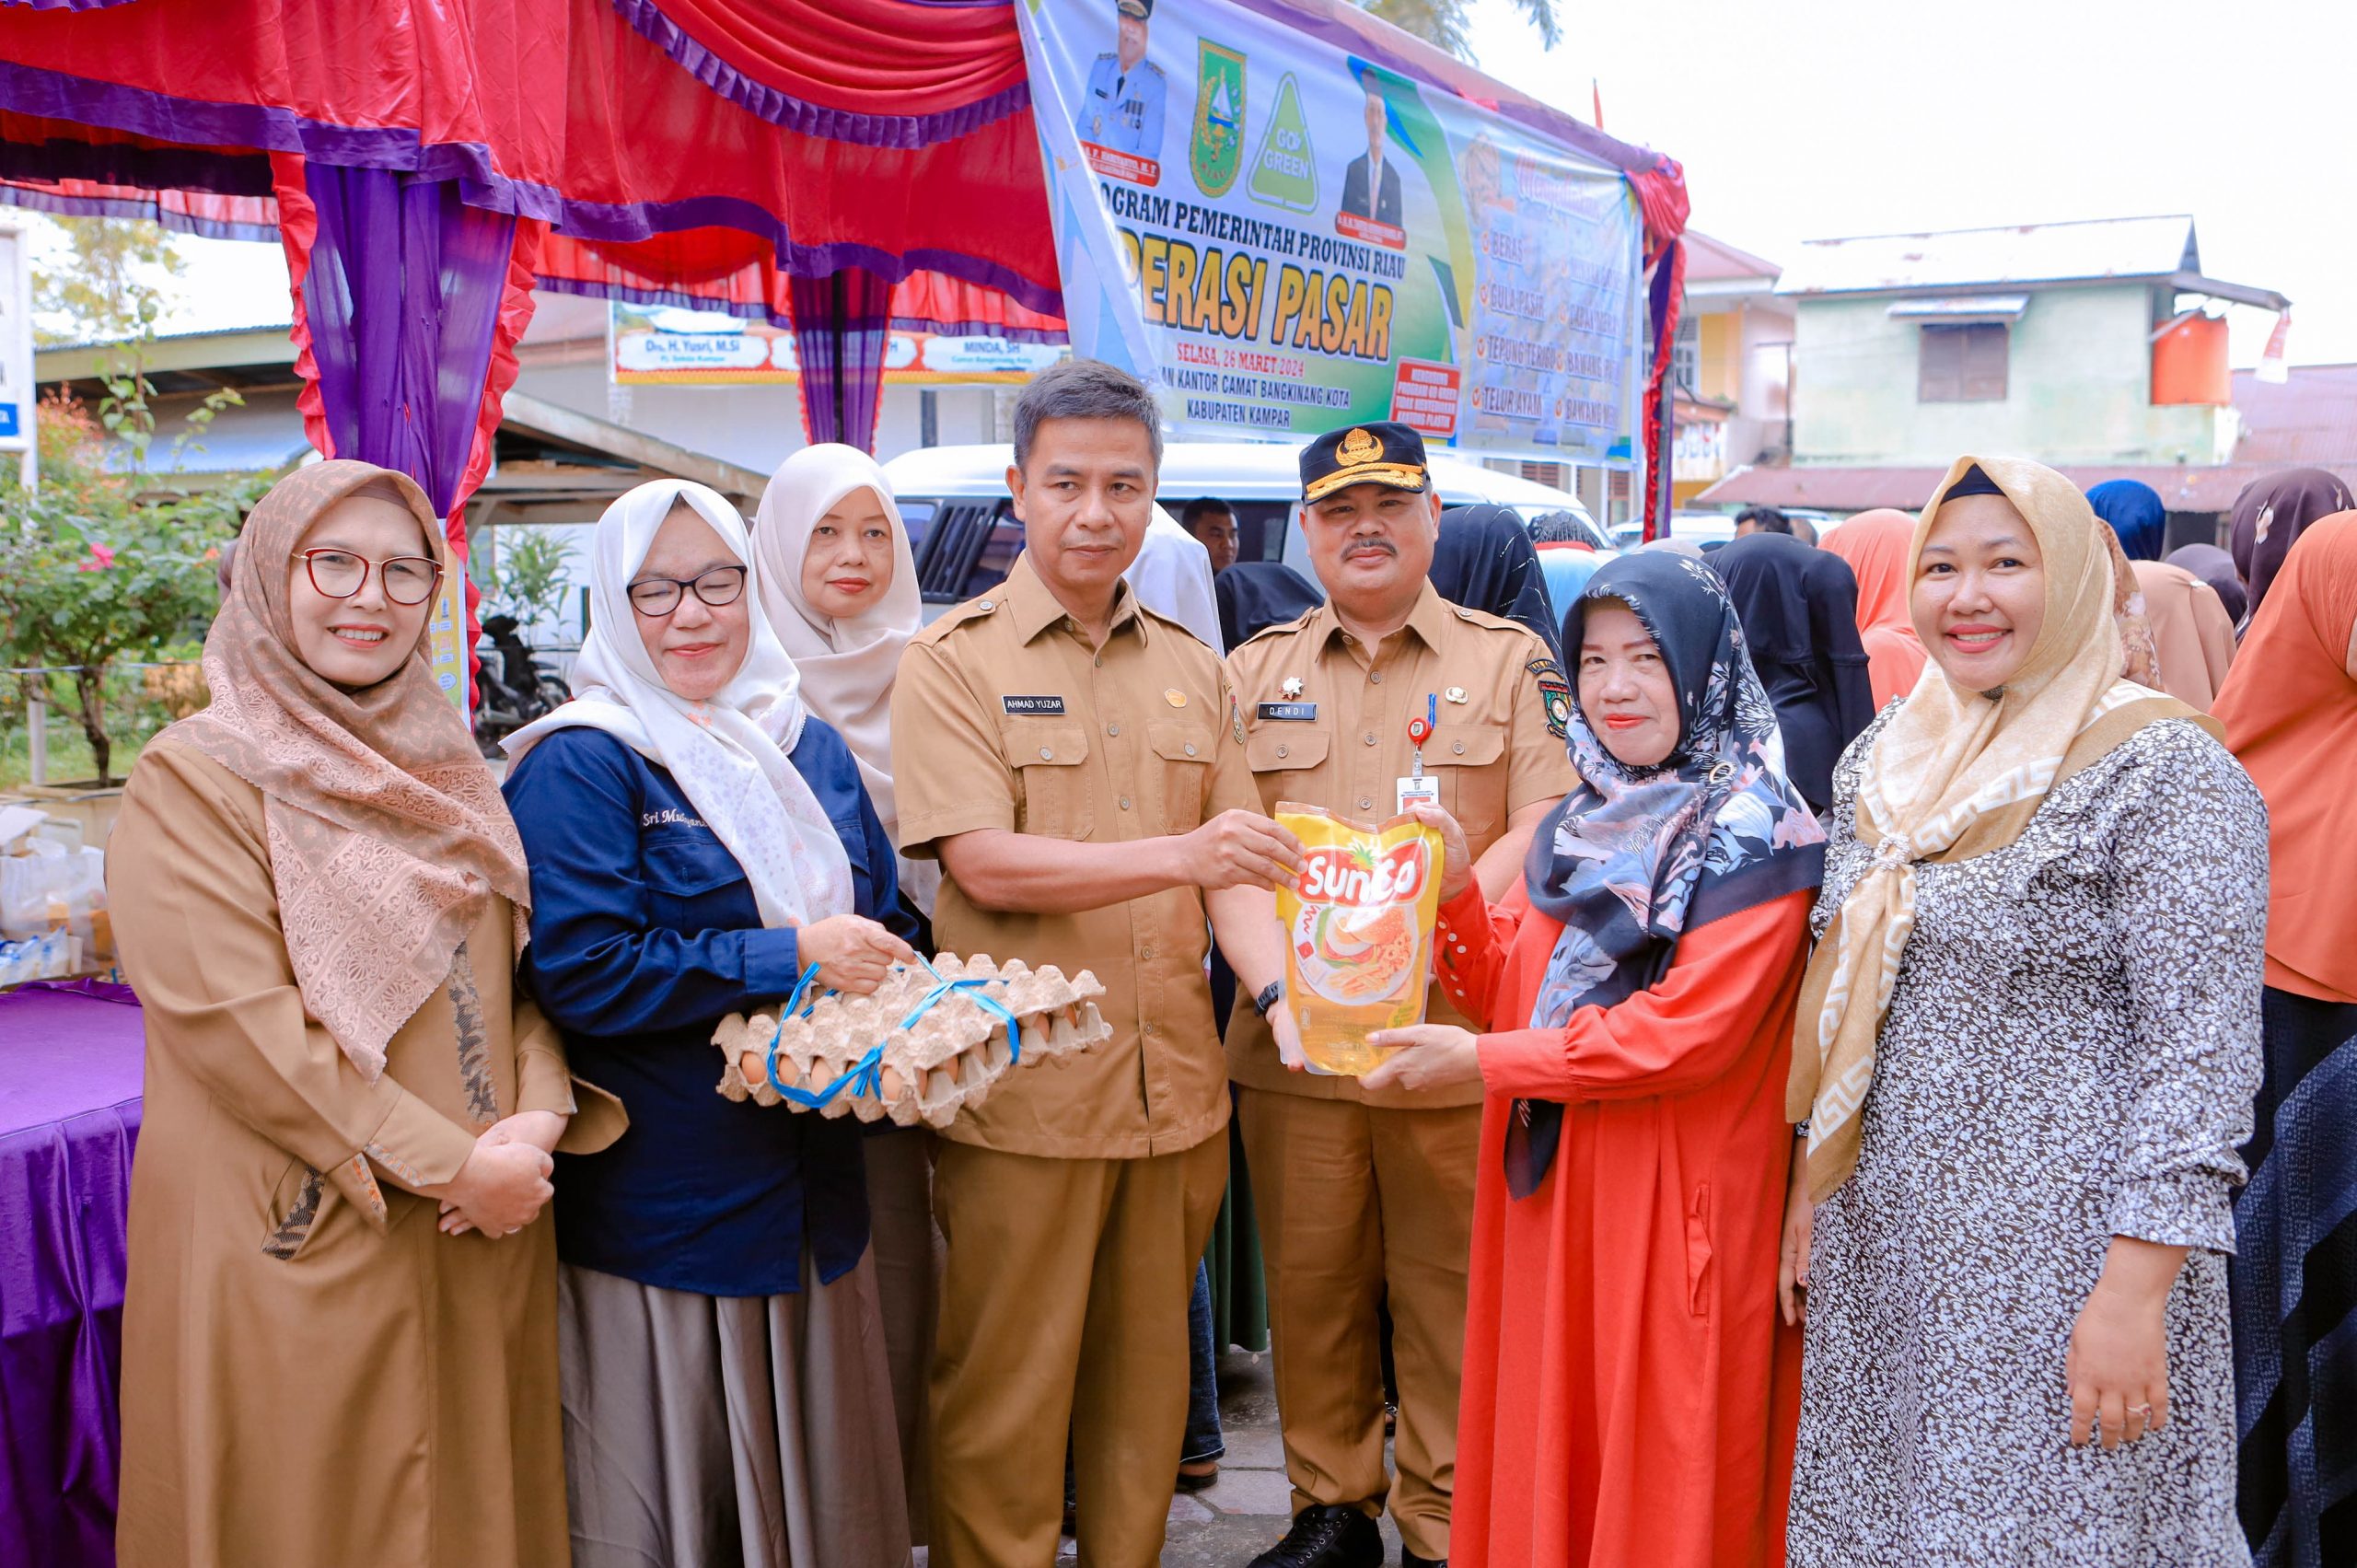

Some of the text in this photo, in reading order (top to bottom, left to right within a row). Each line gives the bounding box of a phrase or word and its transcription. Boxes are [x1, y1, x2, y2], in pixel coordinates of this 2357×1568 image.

[1277, 128, 1301, 151] GO
[1264, 149, 1308, 180] GREEN
[1174, 202, 1295, 255] PEMERINTAH
[1298, 232, 1370, 272] PROVINSI
[1374, 251, 1406, 280] RIAU
[1492, 231, 1524, 263] BERAS
[1271, 263, 1394, 361] PASAR
[1491, 283, 1545, 319] GULA PASIR
[683, 339, 713, 354] Yusri,
[715, 339, 740, 352] M.Si
[964, 340, 1021, 354] MINDA, SH
[1177, 343, 1304, 377] SELASA, 26 MARET 2024
[1487, 335, 1556, 370] TEPUNG TERIGU
[1567, 351, 1602, 379] BAWANG
[1178, 369, 1218, 391] KANTOR
[1223, 373, 1257, 397] CAMAT
[1261, 380, 1323, 405] BANGKINANG
[1326, 389, 1350, 407] KOTA
[1483, 386, 1543, 417] TELUR AYAM
[1187, 399, 1290, 427] KABUPATEN KAMPAR
[1566, 398, 1602, 424] BAWANG
[1007, 699, 1062, 710] AHMAD YUZAR
[1269, 706, 1305, 716] DENDI
[643, 811, 659, 827] Sri
